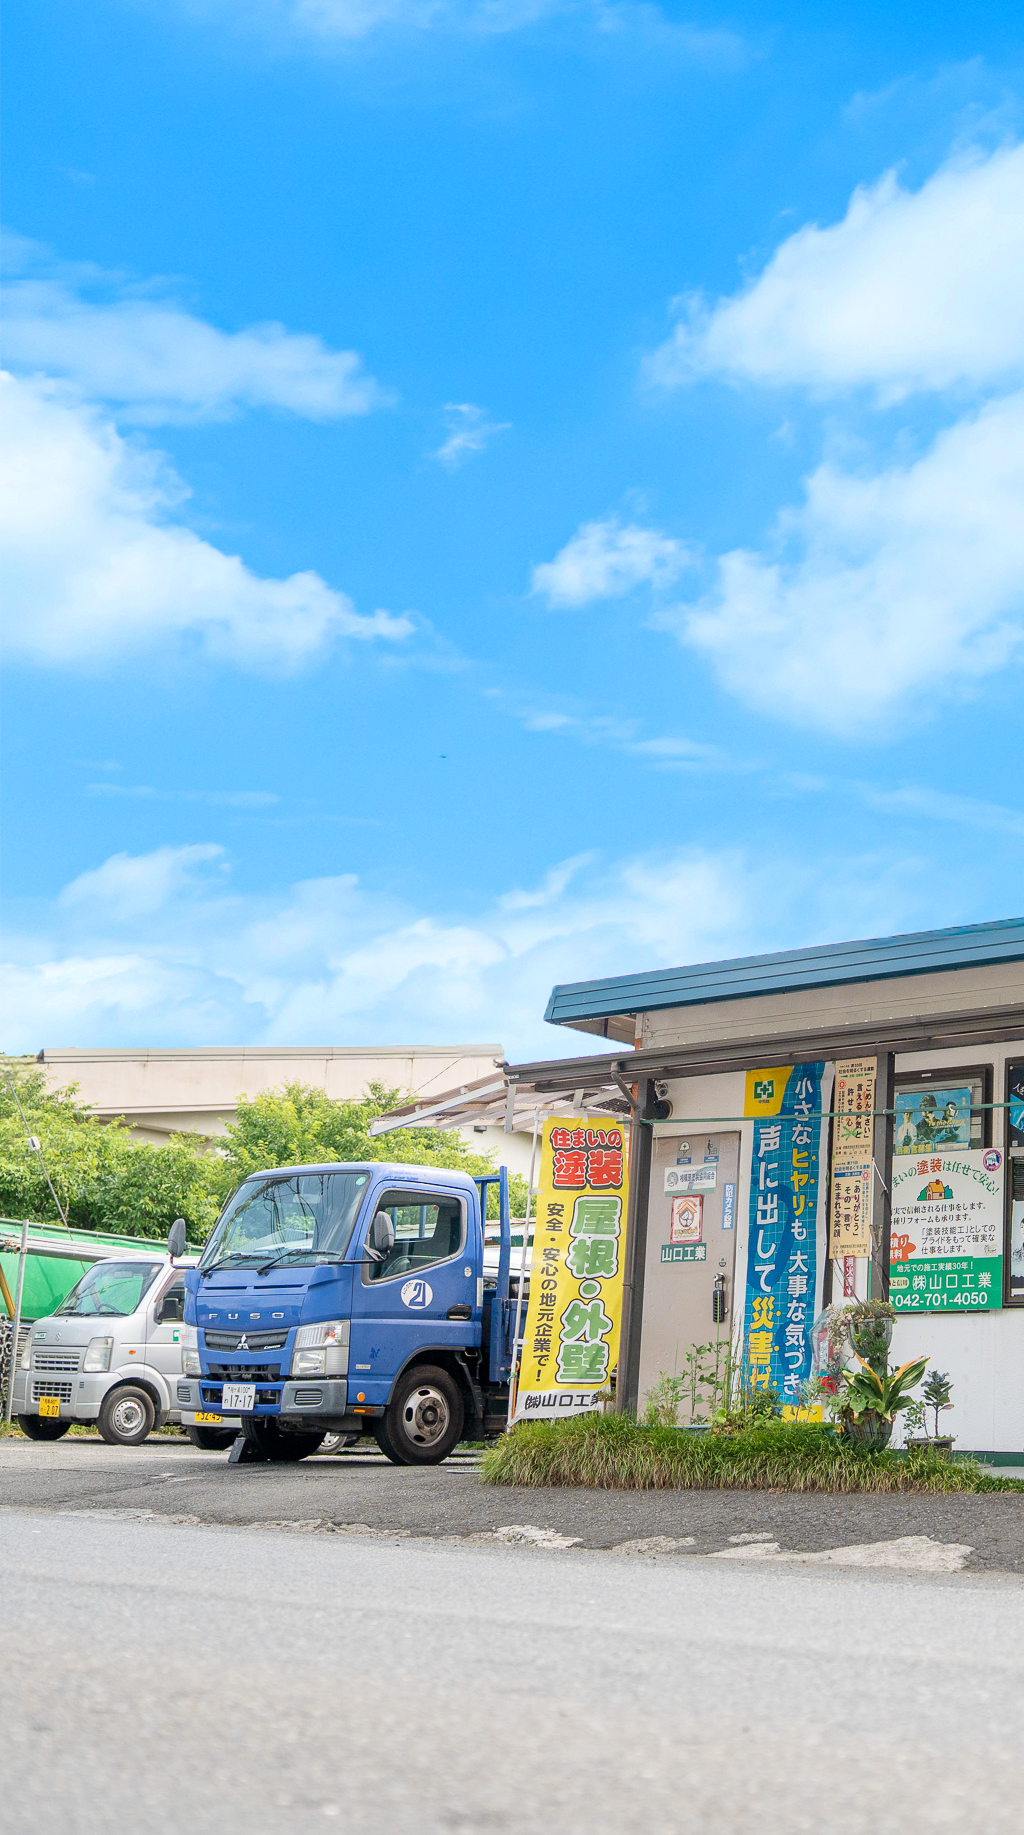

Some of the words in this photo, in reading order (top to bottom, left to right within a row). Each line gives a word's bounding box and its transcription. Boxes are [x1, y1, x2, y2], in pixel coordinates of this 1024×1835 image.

[863, 1079, 873, 1139] 「ごめんさい」
[551, 1128, 622, 1149] 住まいの
[553, 1150, 622, 1188] 塗装
[892, 1158, 1000, 1195] まいの塗装は任せて安心!
[833, 1182, 842, 1238] 生まれる笑顔
[891, 1202, 986, 1215] 実で信頼される仕事をします。
[891, 1213, 971, 1226] 種リフォームも承ります。
[890, 1237, 908, 1248] 積り
[921, 1234, 996, 1245] プライドをもって確実な
[661, 1245, 706, 1262] 山口工業
[749, 1125, 782, 1390] 声に出して災害ゼ
[921, 1245, 966, 1255] 仕事をします。
[896, 1261, 974, 1273] 地元での施工実績30年!
[557, 1197, 621, 1382] 屋根・外壁
[912, 1272, 992, 1291] (株)山口工業
[533, 1203, 565, 1382] 安全・安心の地元企業で!
[895, 1292, 988, 1307] 042-701-4050
[208, 1312, 285, 1320] FUSO
[230, 1395, 252, 1408] 17-17
